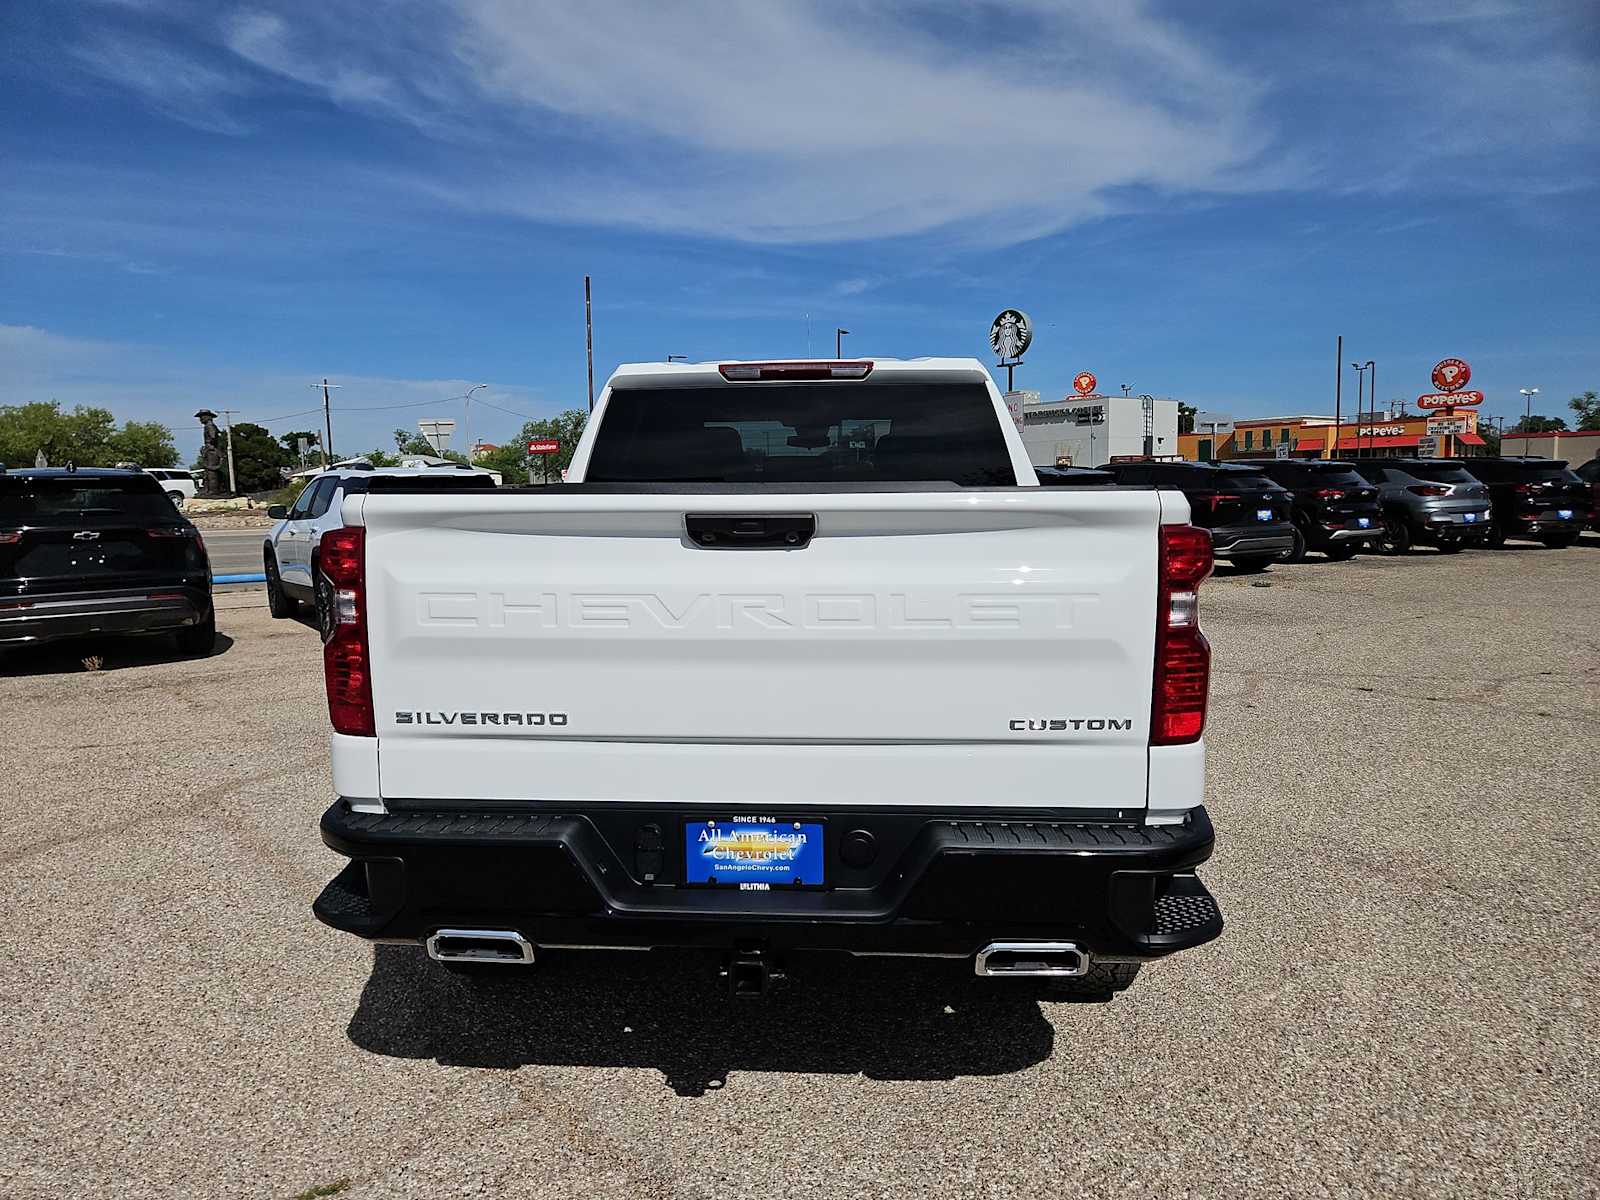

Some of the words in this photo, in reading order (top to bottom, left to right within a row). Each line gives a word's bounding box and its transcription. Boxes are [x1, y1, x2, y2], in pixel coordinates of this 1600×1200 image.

[416, 592, 1101, 629] CHEVROLET
[395, 711, 568, 726] SILVERADO
[1008, 718, 1133, 732] CUSTOM
[732, 815, 757, 824] SINCE
[759, 816, 776, 824] 1946
[697, 828, 722, 843] All
[728, 829, 808, 844] American
[712, 847, 795, 861] Chevrolet
[714, 864, 790, 872] SanAngeloChevy.com
